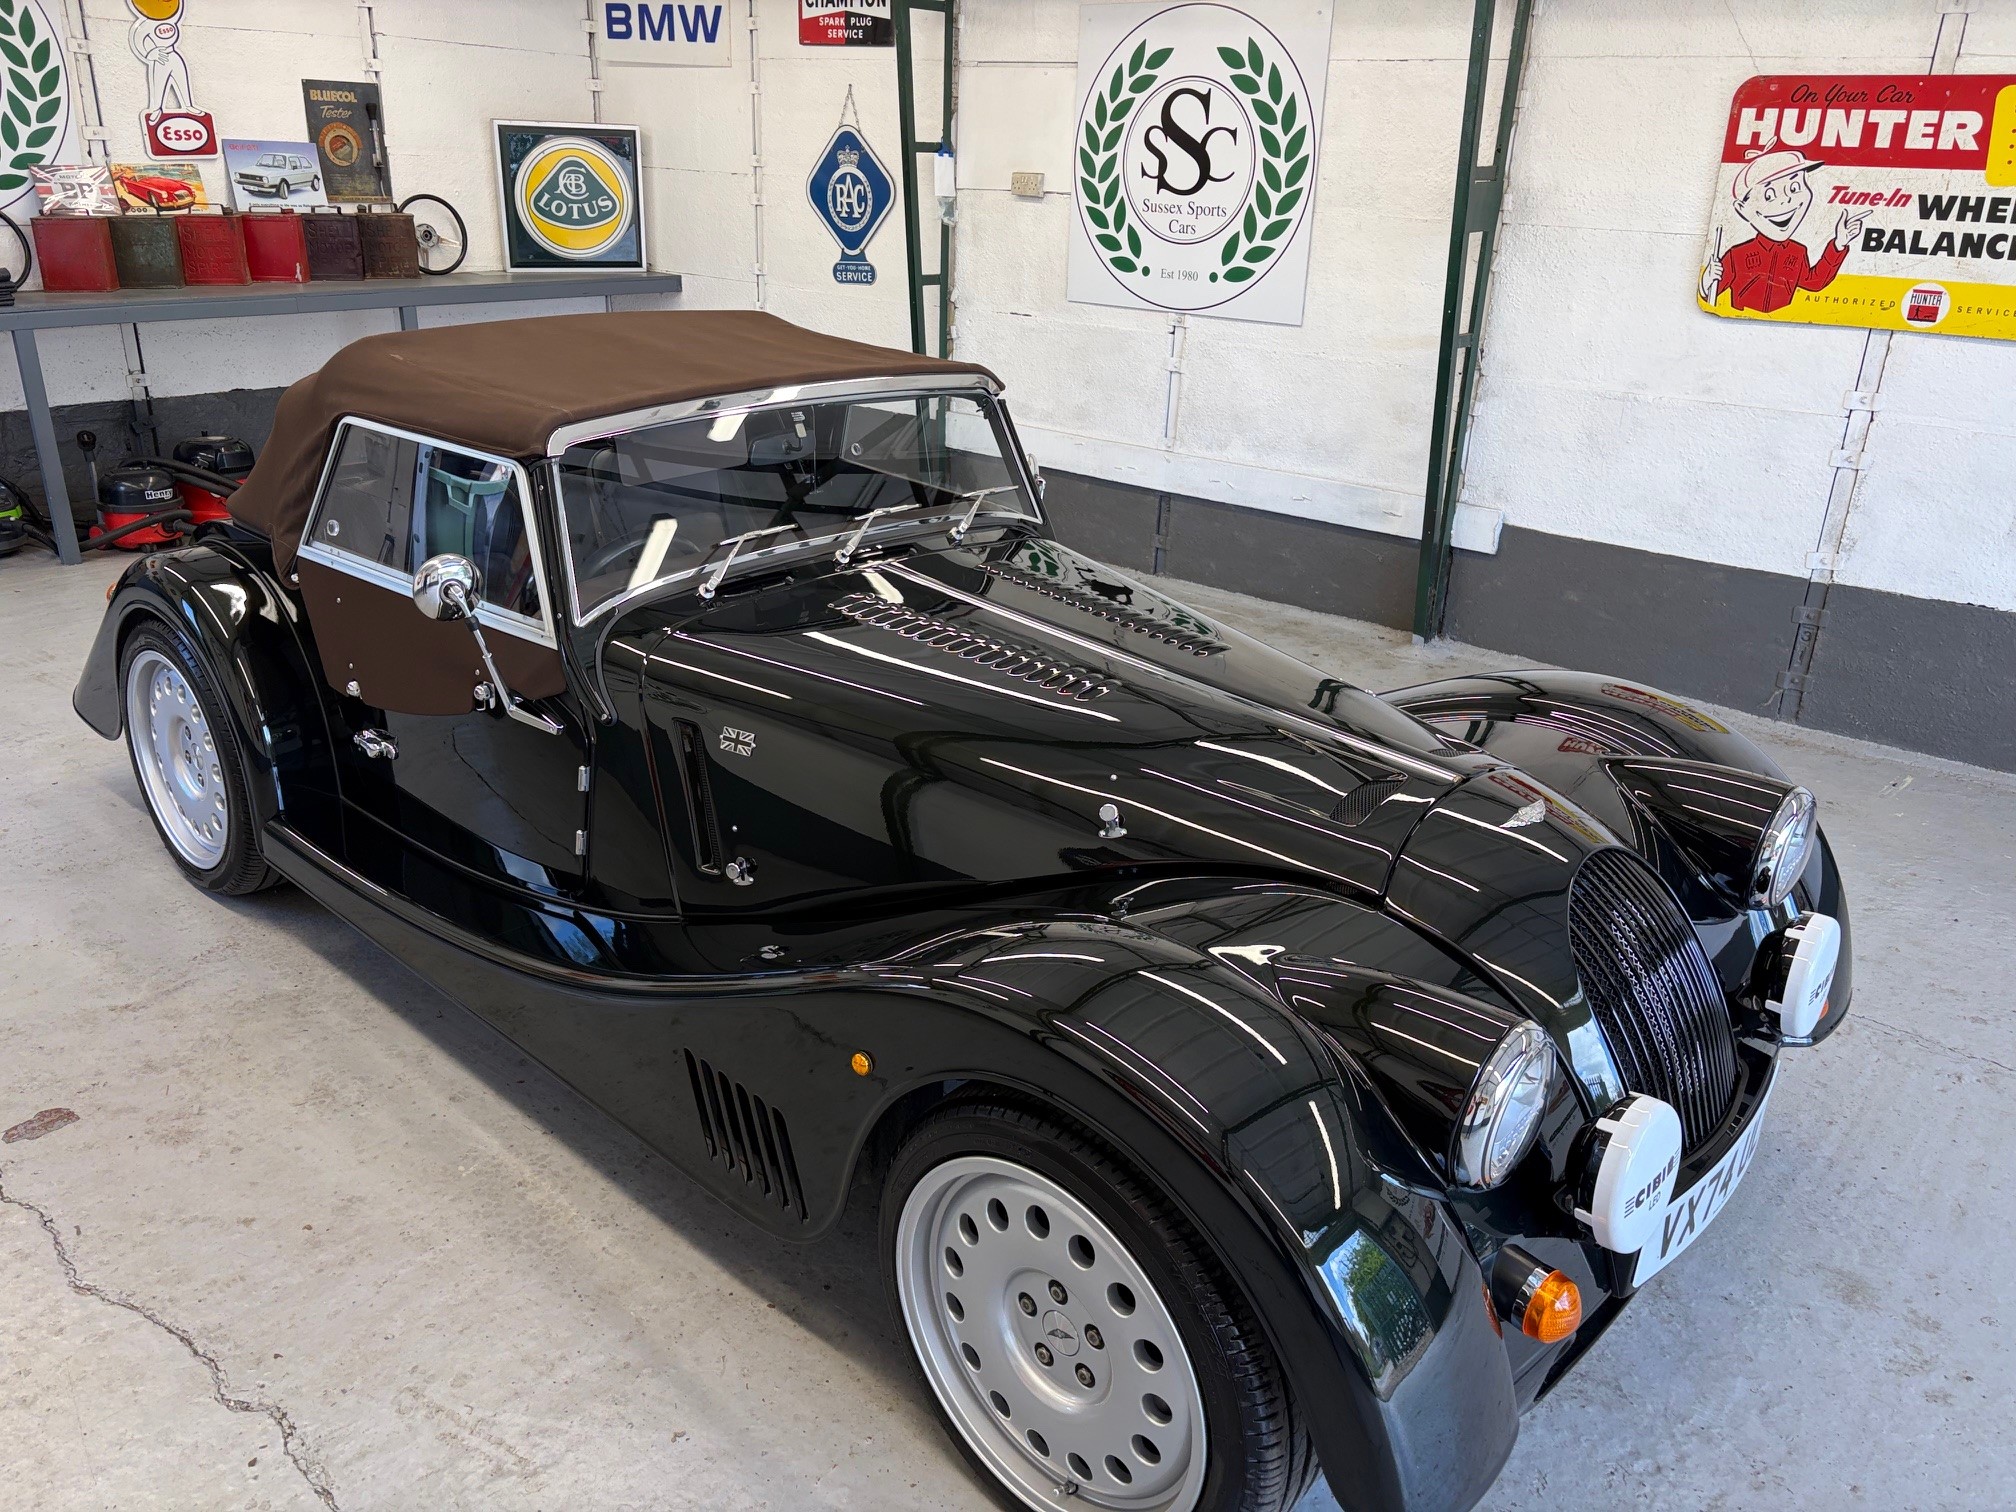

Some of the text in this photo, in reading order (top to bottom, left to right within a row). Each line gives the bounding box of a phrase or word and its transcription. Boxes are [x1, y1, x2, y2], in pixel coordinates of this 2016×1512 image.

[605, 3, 722, 43] BMW
[818, 16, 872, 27] SPARK PLUG
[158, 27, 173, 35] Esso
[827, 29, 863, 39] SERVICE
[309, 89, 357, 103] BLUECOL
[1790, 83, 1915, 109] On Your Car
[320, 105, 352, 119] Tester
[162, 126, 203, 141] Esso
[1736, 107, 1983, 151] HUNTER
[834, 174, 865, 218] RAC
[537, 192, 613, 220] LOTUS
[1142, 197, 1227, 219] Sussex Sports
[1827, 185, 2016, 224] Tune-In WHE
[1168, 219, 1197, 235] Cars
[836, 271, 873, 282] SERVICE
[1160, 268, 1199, 281] Est 1980
[1805, 294, 1896, 308] AUTHORIZED
[1910, 293, 1943, 306] HUNTER
[145, 489, 173, 500] Henry
[1660, 1149, 1739, 1260] VX74
